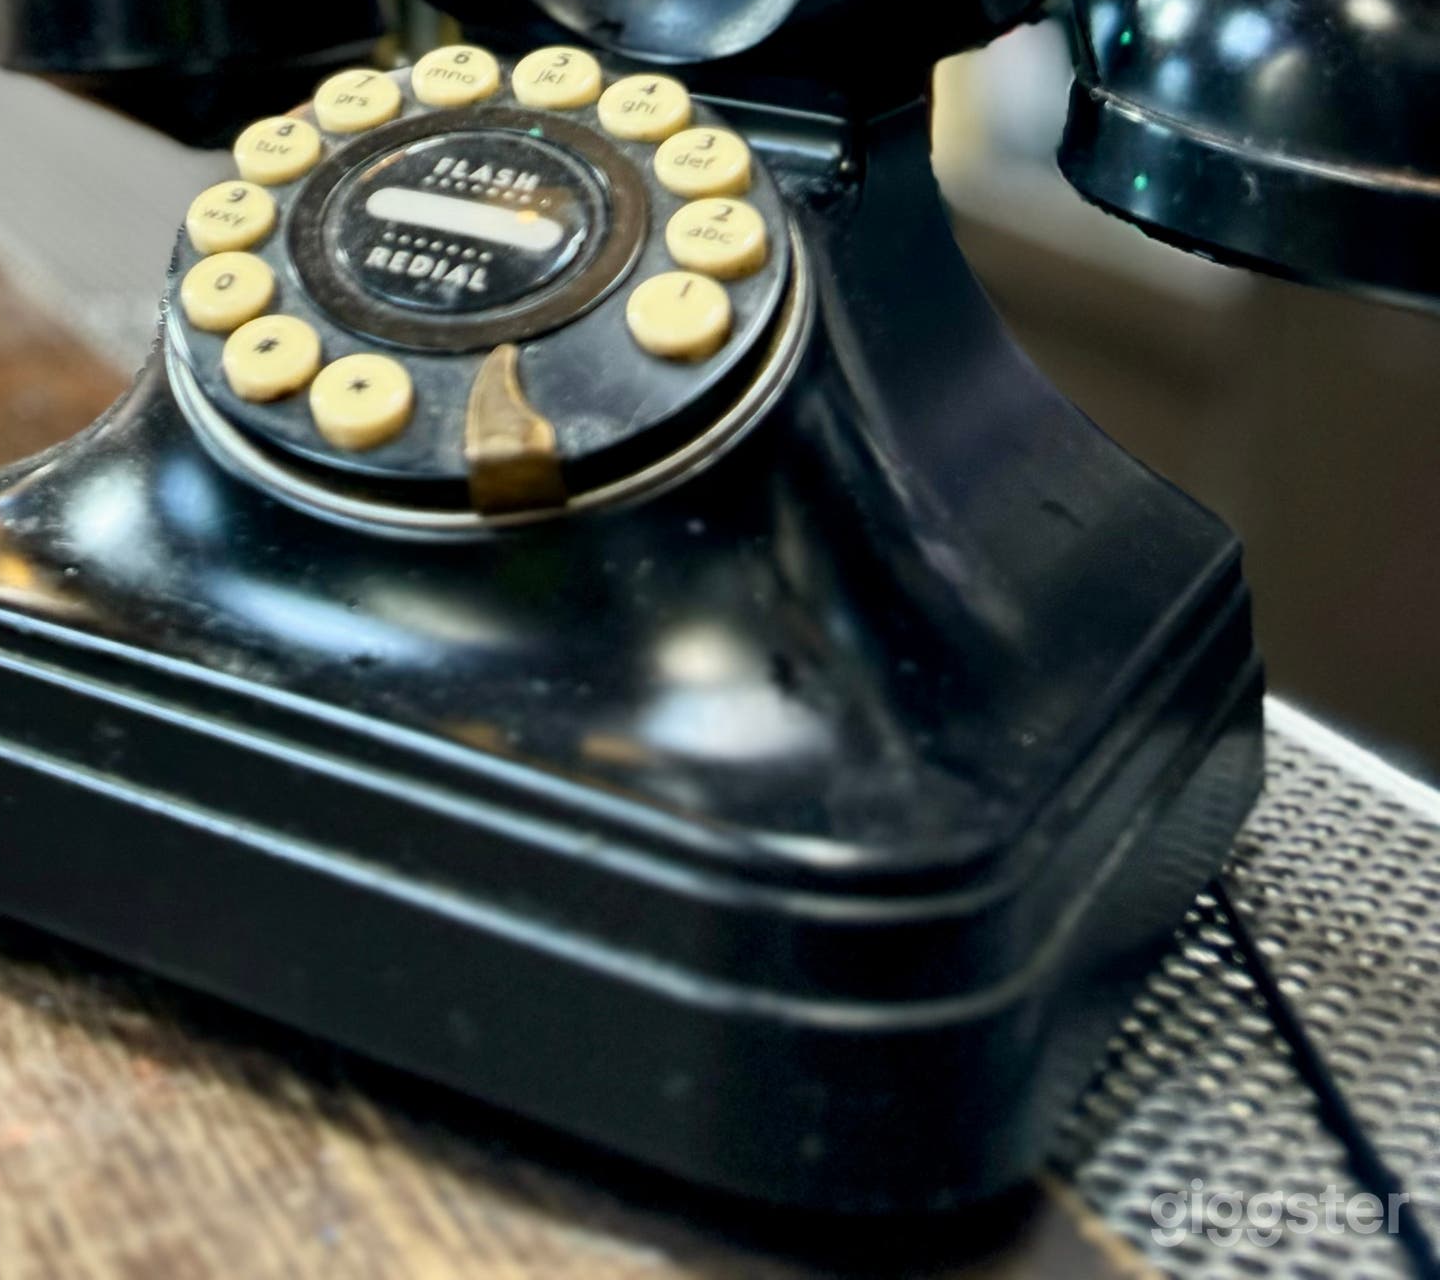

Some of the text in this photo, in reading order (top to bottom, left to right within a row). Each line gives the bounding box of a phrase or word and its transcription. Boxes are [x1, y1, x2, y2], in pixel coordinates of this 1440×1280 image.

[453, 52, 471, 64] 6
[553, 53, 571, 67] 5
[356, 75, 376, 88] 7
[426, 68, 474, 84] mno
[640, 82, 659, 95] 4
[277, 123, 295, 137] 8
[695, 135, 716, 150] 3
[674, 153, 716, 169] def
[432, 156, 542, 192] FLASH
[227, 187, 248, 203] 9
[711, 204, 733, 222] 2
[688, 227, 732, 244] abc
[363, 245, 488, 293] REDIAL
[214, 272, 235, 291] 0
[679, 280, 692, 299] 1
